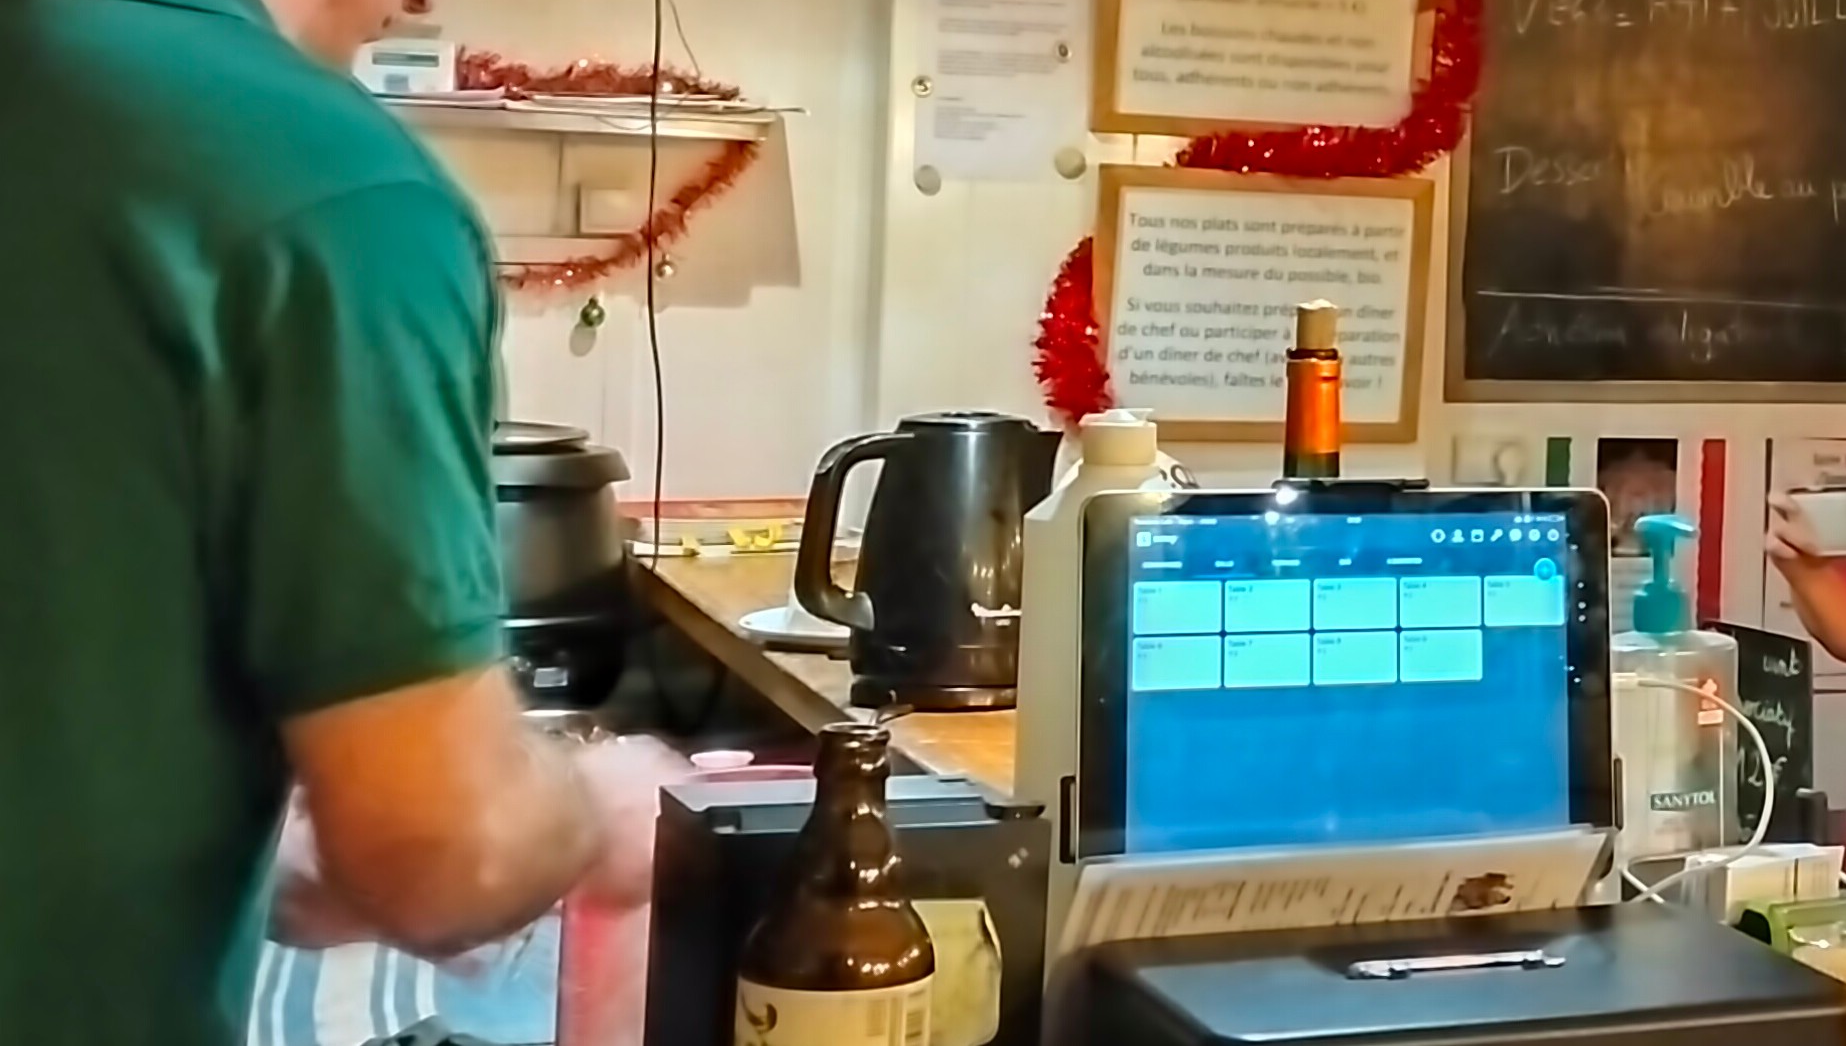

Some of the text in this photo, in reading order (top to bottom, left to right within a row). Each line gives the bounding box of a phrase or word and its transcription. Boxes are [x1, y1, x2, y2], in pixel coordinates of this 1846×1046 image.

[1129, 212, 1165, 228] Tous
[1171, 217, 1197, 229] nos
[1202, 216, 1238, 233] plats
[1244, 220, 1276, 233] sont
[1131, 238, 1150, 252] de
[1155, 239, 1219, 256] légumes
[1225, 243, 1289, 258] produits
[1143, 263, 1179, 277] dans
[1184, 264, 1197, 278] la
[1202, 267, 1259, 280] mesure
[1264, 266, 1283, 281] du
[1127, 297, 1141, 311] Si
[1145, 300, 1181, 313] vous
[1185, 301, 1259, 315] souhaitez
[1117, 322, 1136, 336] de
[1141, 323, 1174, 337] chef
[1179, 325, 1199, 338] ou
[1204, 325, 1277, 343] participer
[1204, 348, 1223, 363] de
[1227, 349, 1260, 363] chef
[1348, 354, 1395, 367] autres
[1269, 375, 1283, 388] le
[1653, 790, 1717, 810] SANYTOL
